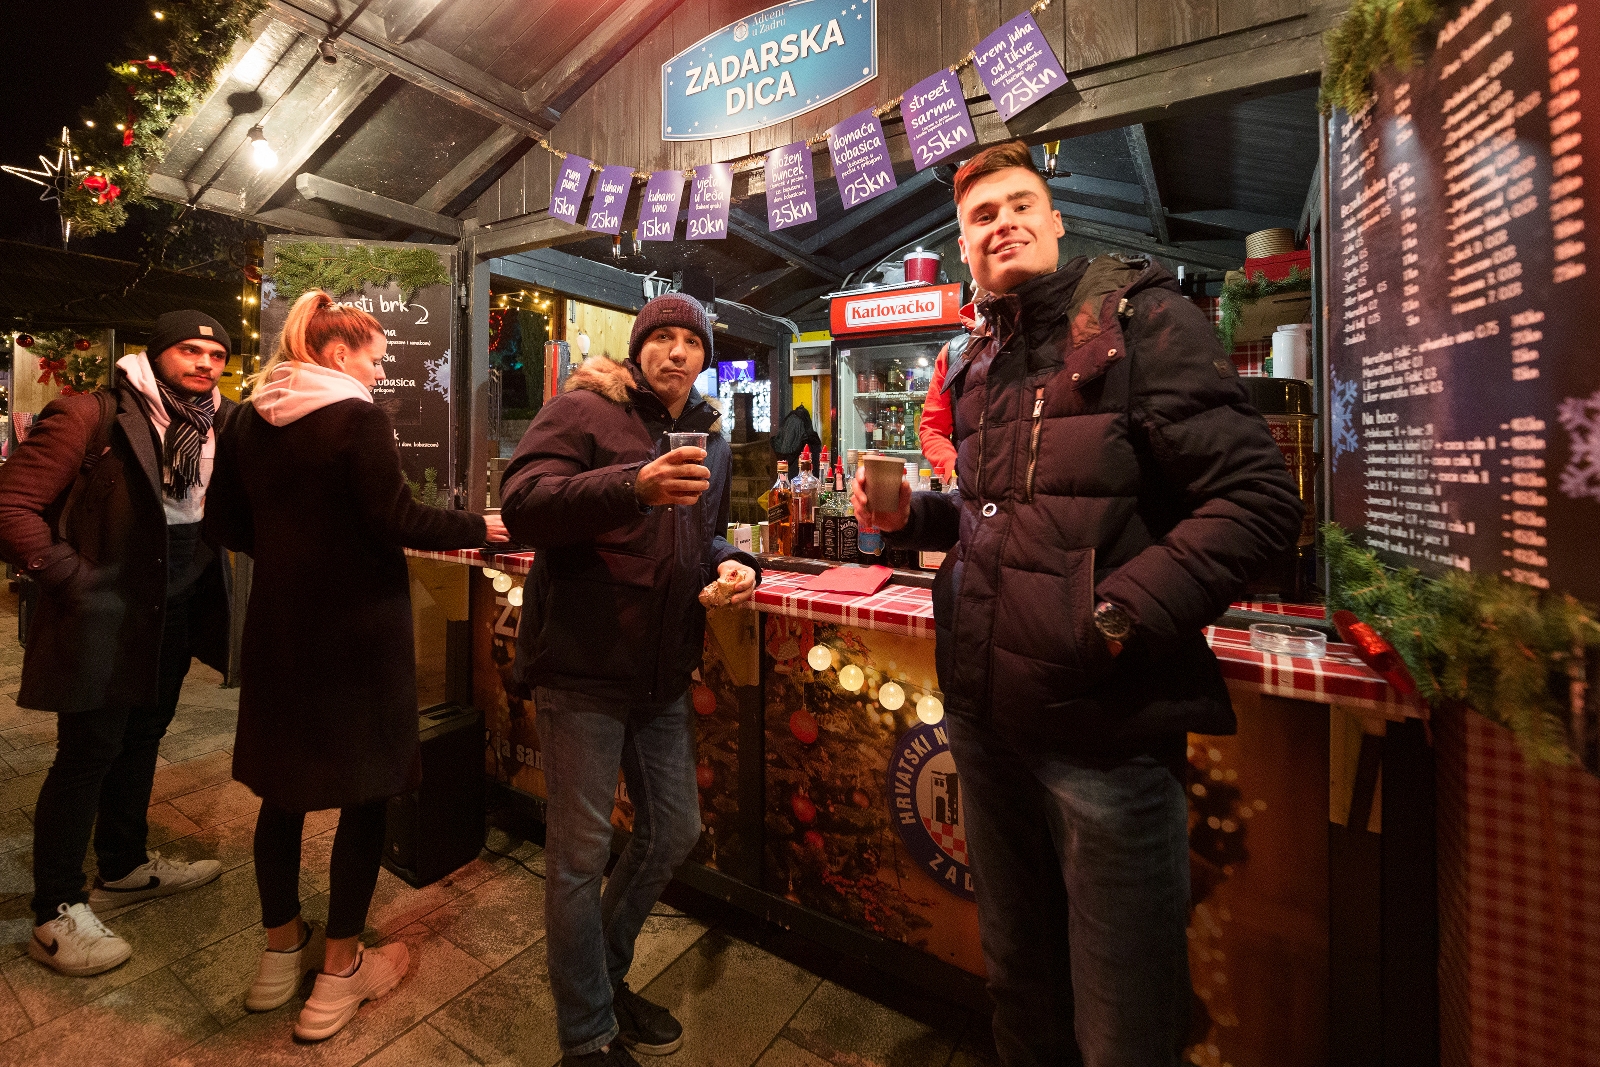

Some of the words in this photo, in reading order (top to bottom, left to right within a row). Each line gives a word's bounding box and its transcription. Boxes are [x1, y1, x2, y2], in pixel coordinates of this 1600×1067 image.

[752, 8, 785, 26] Advent
[760, 19, 786, 34] Zadru
[976, 41, 1006, 67] krem
[1007, 22, 1034, 46] juha
[685, 18, 845, 96] ZADARSKA
[991, 58, 1004, 76] od
[1004, 42, 1034, 65] tikve
[726, 70, 796, 116] DICA
[910, 79, 950, 112] street
[1001, 68, 1057, 114] 25kn
[911, 97, 956, 128] sarma
[834, 122, 876, 150] domaća
[917, 126, 968, 164] 35kn
[772, 151, 802, 170] složeni
[834, 136, 881, 166] kobasica
[565, 168, 580, 181] rum
[772, 164, 804, 182] buncek
[560, 179, 579, 192] punč
[601, 179, 624, 194] kuhani
[697, 174, 721, 192] vjeta
[845, 171, 890, 204] 25kn
[604, 194, 614, 207] gin
[648, 189, 676, 202] kuhano
[694, 194, 700, 202] u
[554, 196, 575, 216] 15kn
[652, 202, 667, 213] vino
[772, 200, 812, 228] 35kn
[591, 210, 618, 229] 25kn
[642, 219, 671, 238] 15kn
[690, 214, 724, 238] 30kn
[380, 294, 409, 312] brk
[852, 300, 934, 319] Karlovačko
[378, 378, 416, 387] obasica
[895, 734, 932, 825] HRVATSKI
[933, 726, 948, 746] N
[929, 853, 974, 892] ZAD
